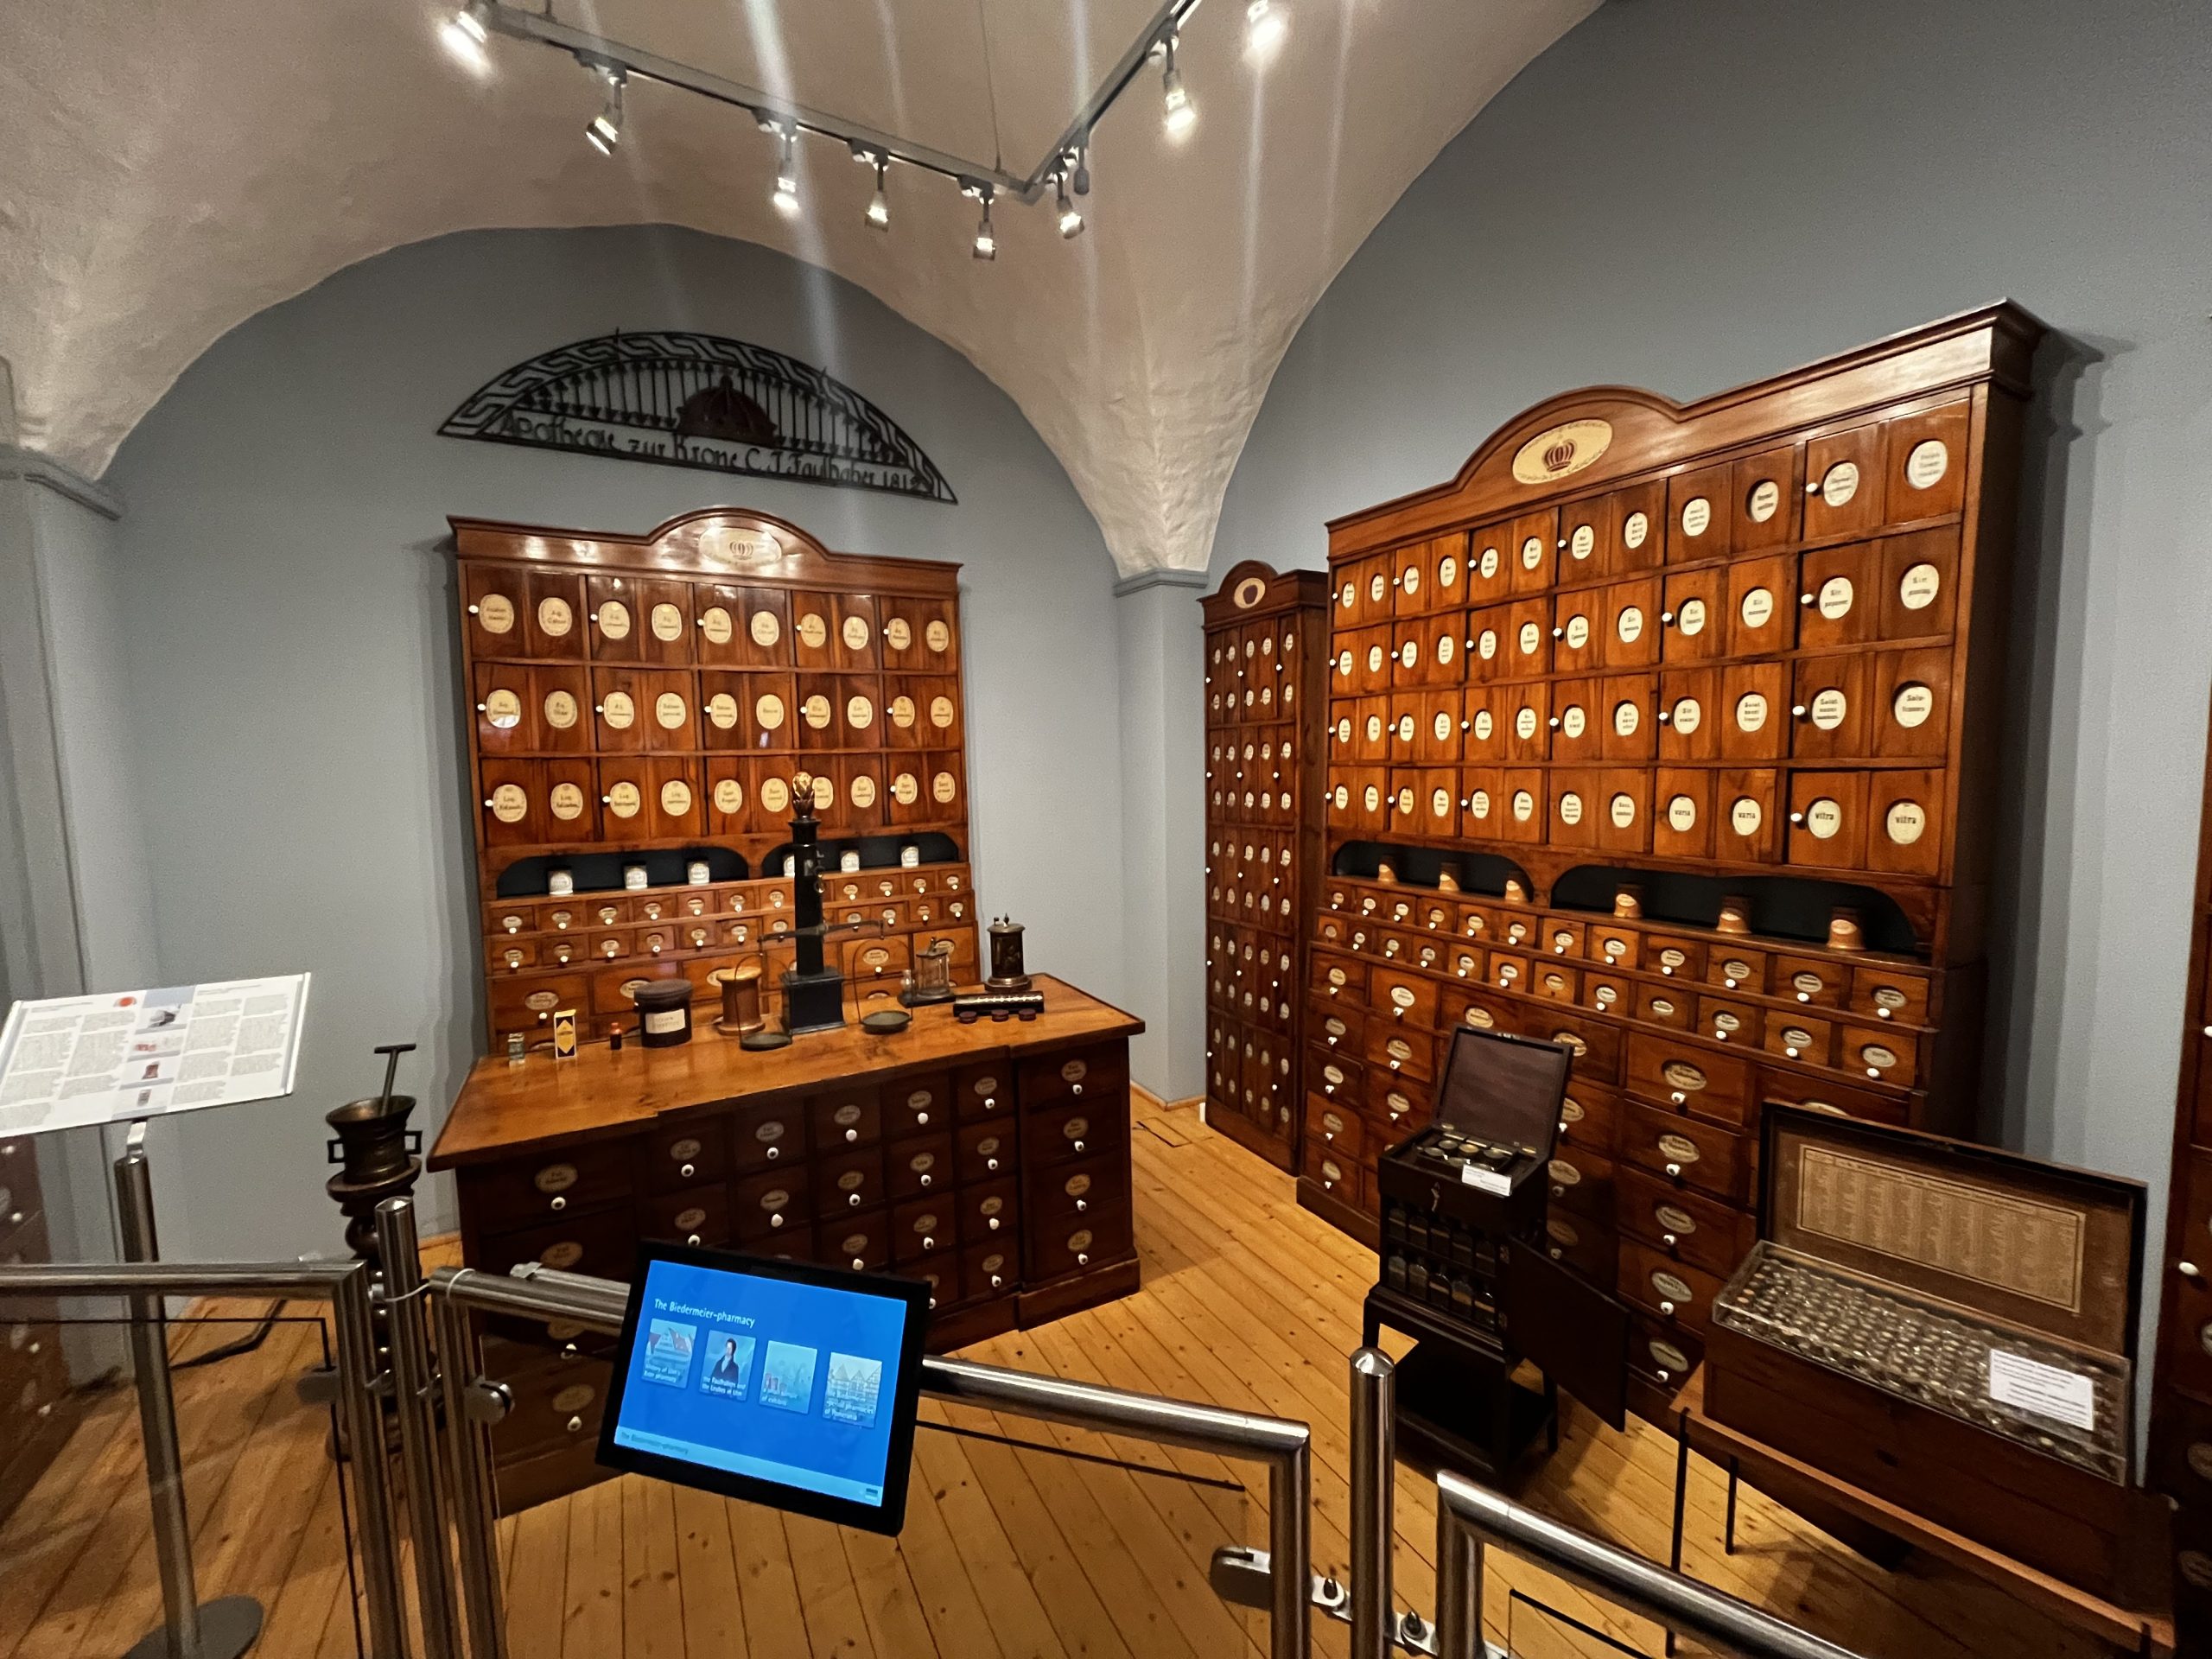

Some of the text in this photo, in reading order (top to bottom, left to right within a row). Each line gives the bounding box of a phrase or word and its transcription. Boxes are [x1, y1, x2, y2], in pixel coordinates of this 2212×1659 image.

[672, 433, 737, 469] Krone
[654, 1299, 755, 1329] The Biedermeier-pharmacy
